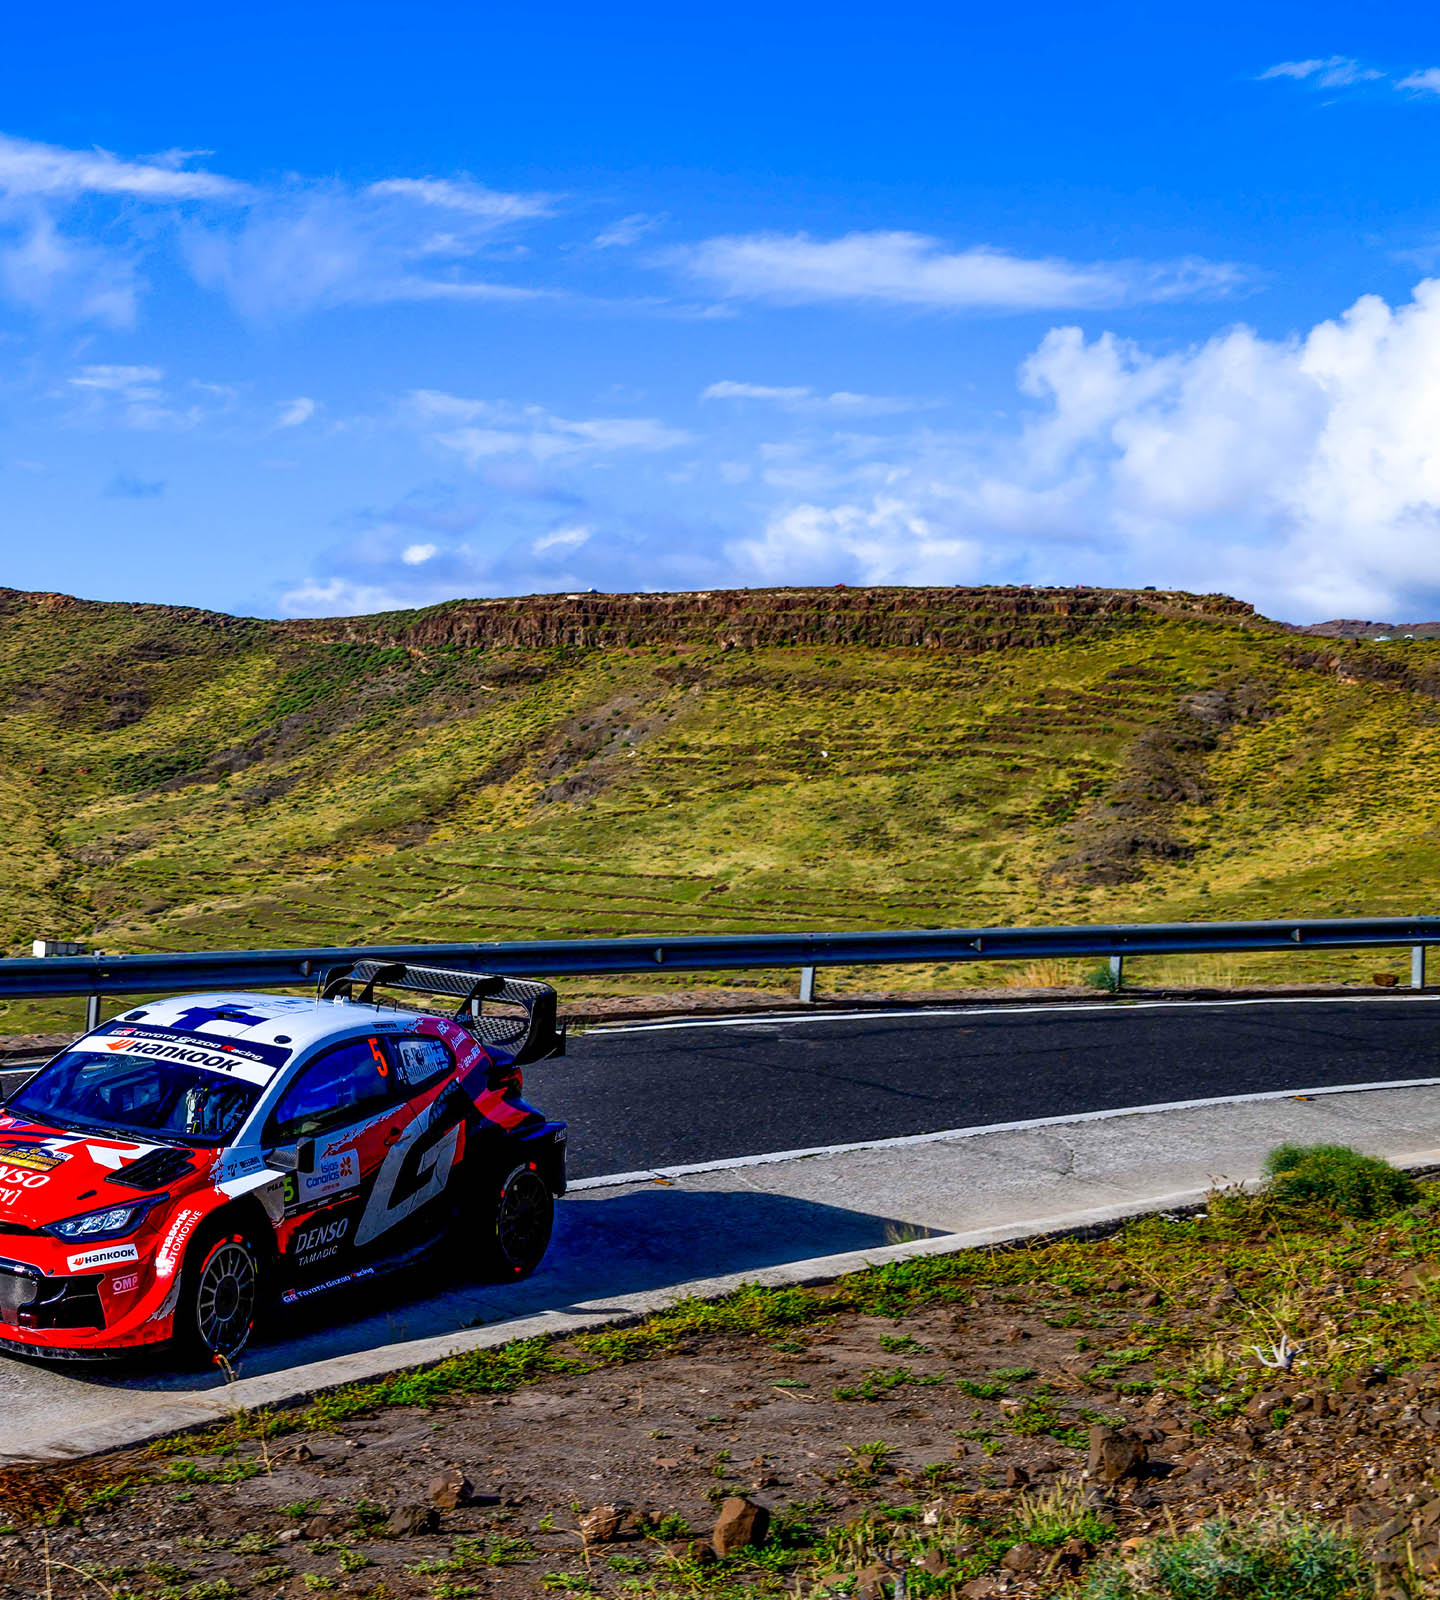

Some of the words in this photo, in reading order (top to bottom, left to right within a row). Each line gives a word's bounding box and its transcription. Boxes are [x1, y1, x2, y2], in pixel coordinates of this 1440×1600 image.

[134, 1030, 178, 1040] TOYOTA
[221, 1045, 264, 1061] Racing
[368, 1037, 389, 1078] 5
[306, 1171, 340, 1189] Canarias
[321, 1162, 339, 1174] Islas
[283, 1176, 295, 1202] 5
[168, 1210, 203, 1273] AUTOMOTIVE
[295, 1217, 349, 1254] DENSO
[112, 1275, 139, 1292] OMP
[297, 1284, 326, 1297] TOYOTA
